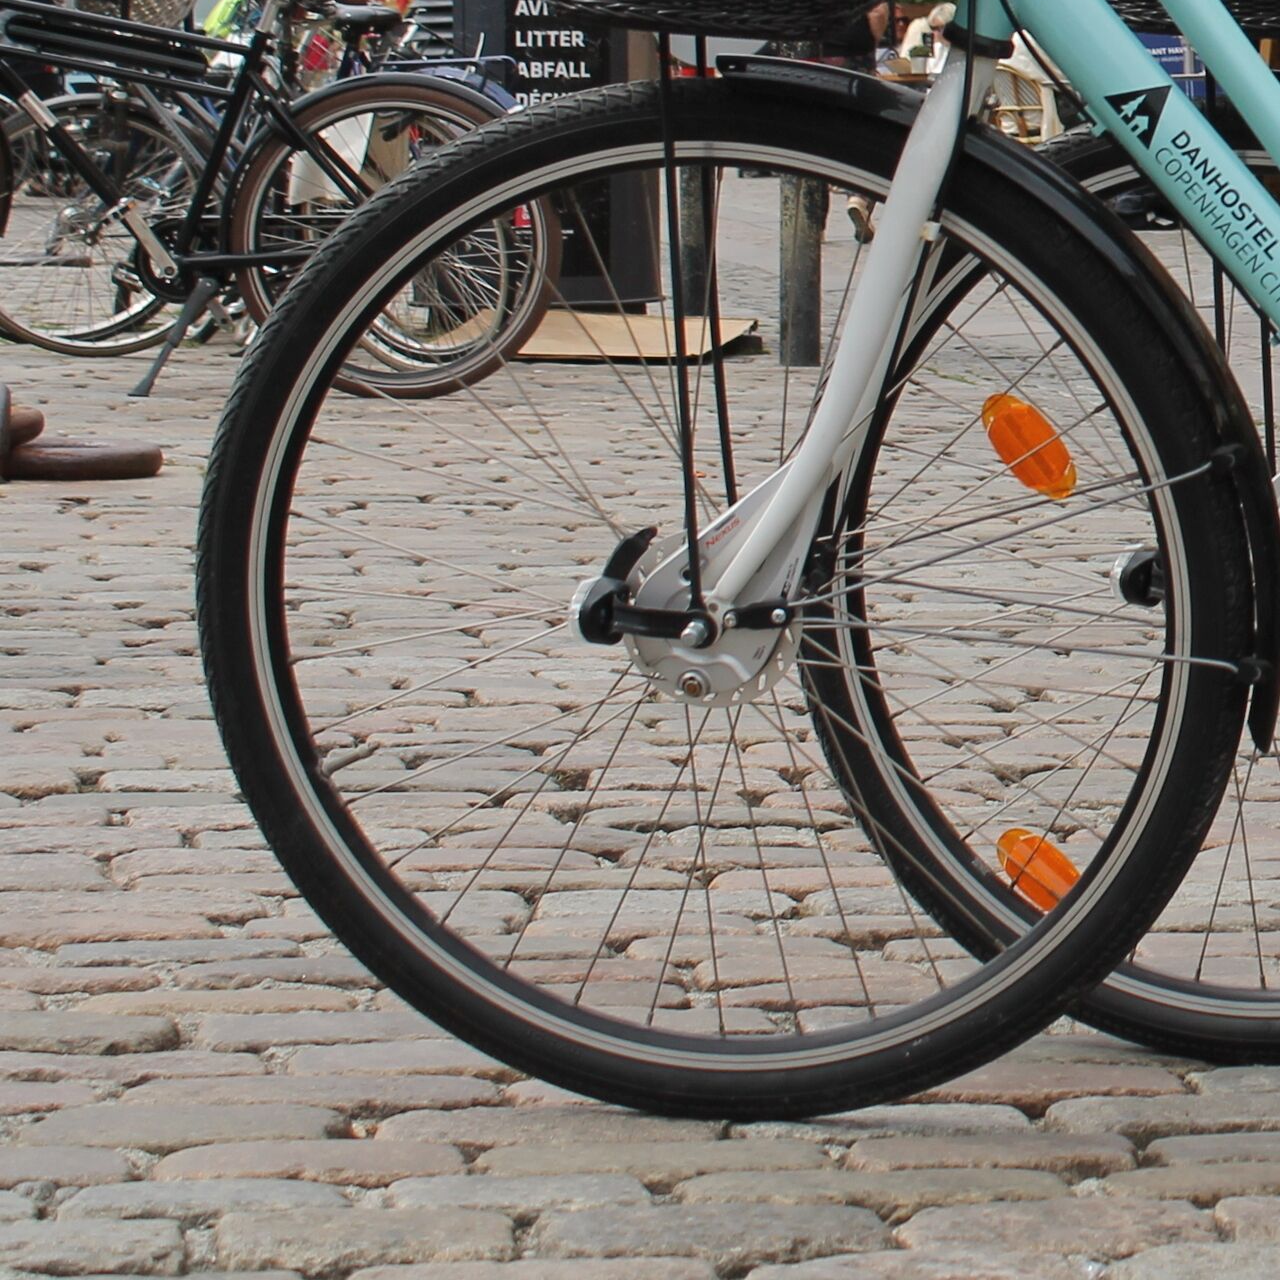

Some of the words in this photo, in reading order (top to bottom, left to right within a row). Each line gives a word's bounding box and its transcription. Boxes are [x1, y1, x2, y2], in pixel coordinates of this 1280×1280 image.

[515, 30, 586, 48] LITTER
[517, 61, 592, 79] ABFALL
[1155, 147, 1264, 275] COPENHAGEN
[1171, 130, 1280, 262] DANHOSTEL
